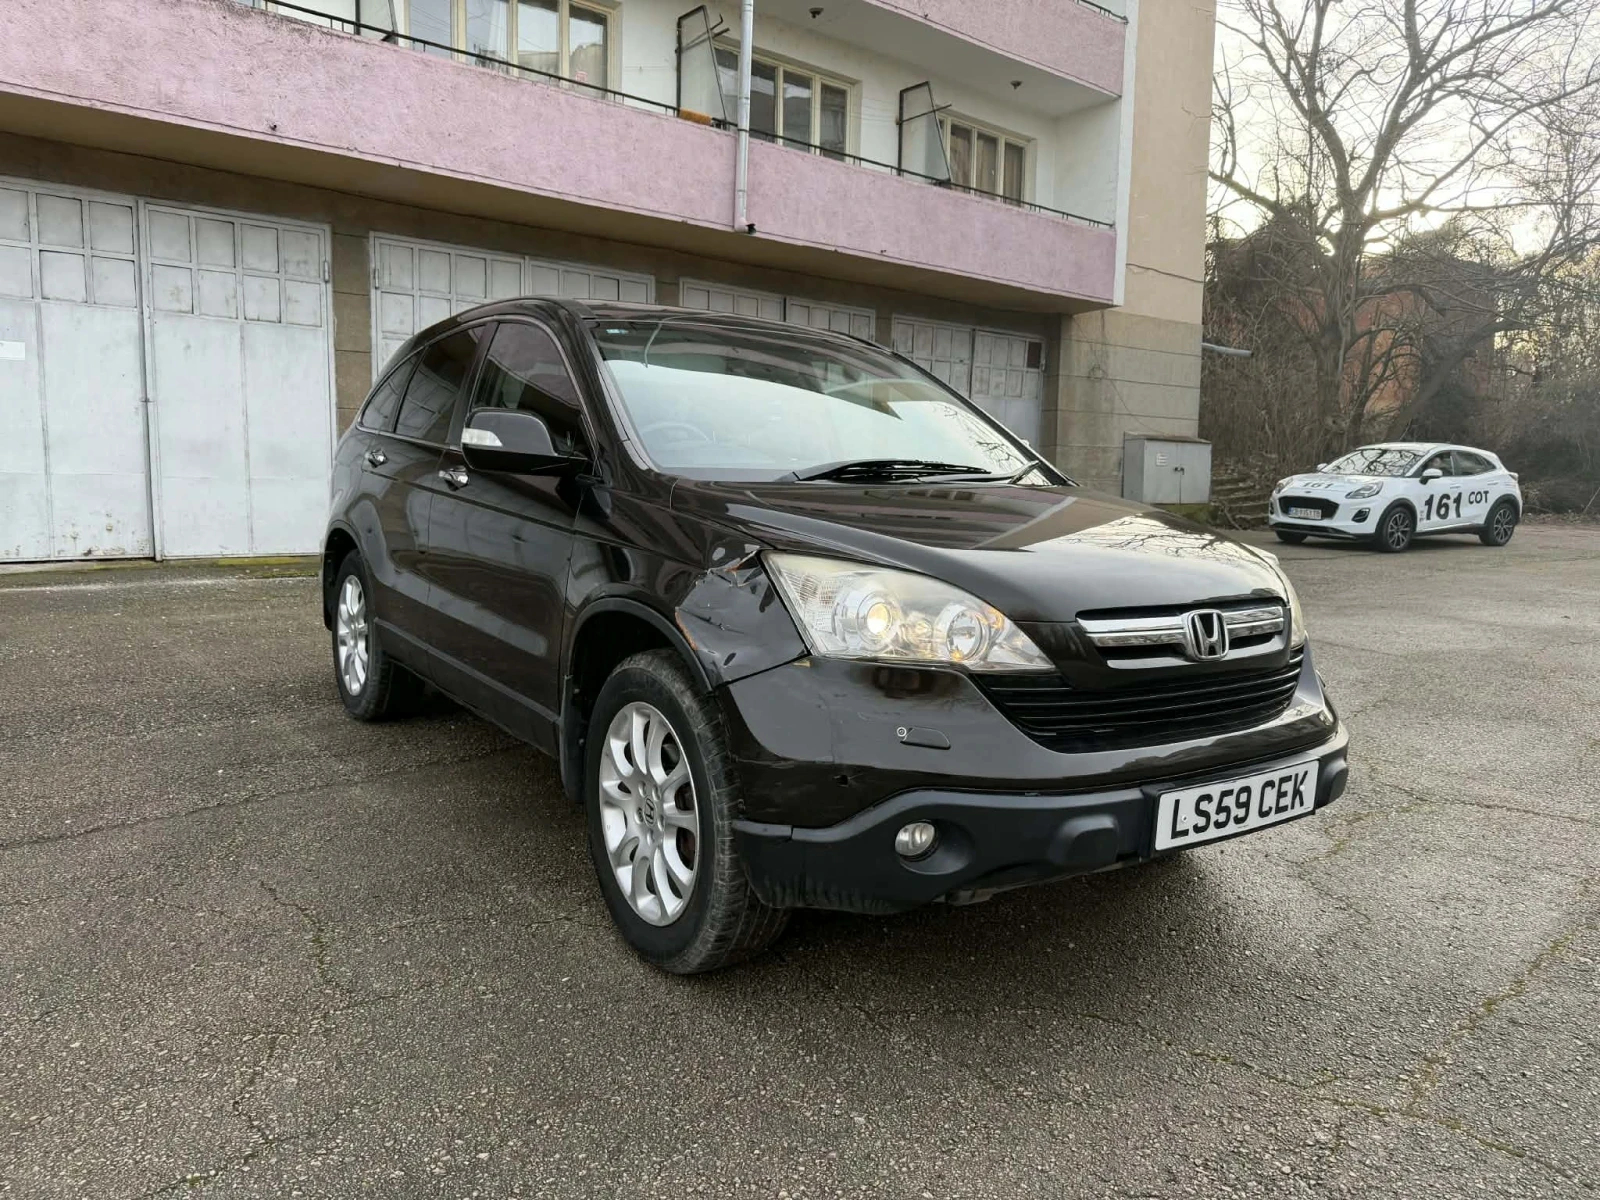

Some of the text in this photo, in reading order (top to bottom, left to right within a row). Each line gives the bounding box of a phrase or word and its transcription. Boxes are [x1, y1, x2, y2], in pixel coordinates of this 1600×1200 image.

[1424, 491, 1463, 521] 161
[1170, 770, 1309, 840] LS59 CEK
